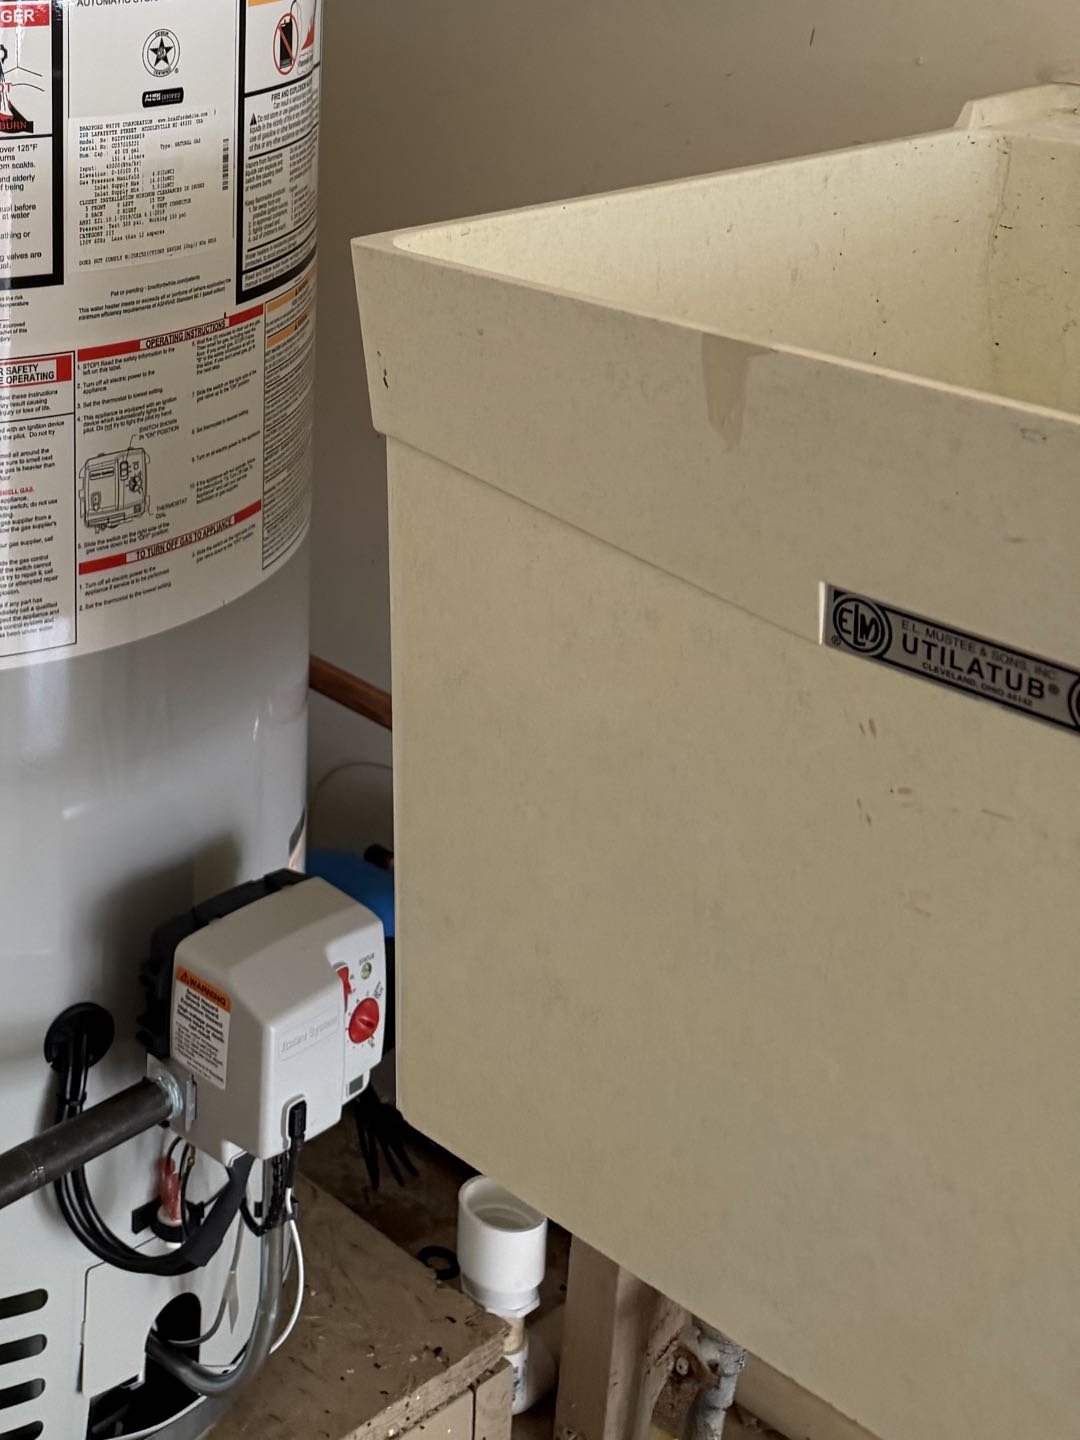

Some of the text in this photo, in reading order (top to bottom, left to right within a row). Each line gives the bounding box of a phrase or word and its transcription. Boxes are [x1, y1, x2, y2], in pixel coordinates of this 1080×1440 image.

[0, 146, 15, 154] over
[11, 161, 36, 169] scalds.
[145, 319, 226, 349] OPERATING INSTRUCTIONS
[5, 363, 39, 376] SAFETY
[5, 370, 55, 384] OPERATING
[136, 515, 234, 560] TO TURN OFF GAS TO APPLIANCE
[838, 602, 880, 647] ELM
[925, 628, 976, 654] MUSTEE
[979, 646, 987, 658] &
[981, 683, 1004, 697] OHIO
[188, 977, 226, 1007] WARNING
